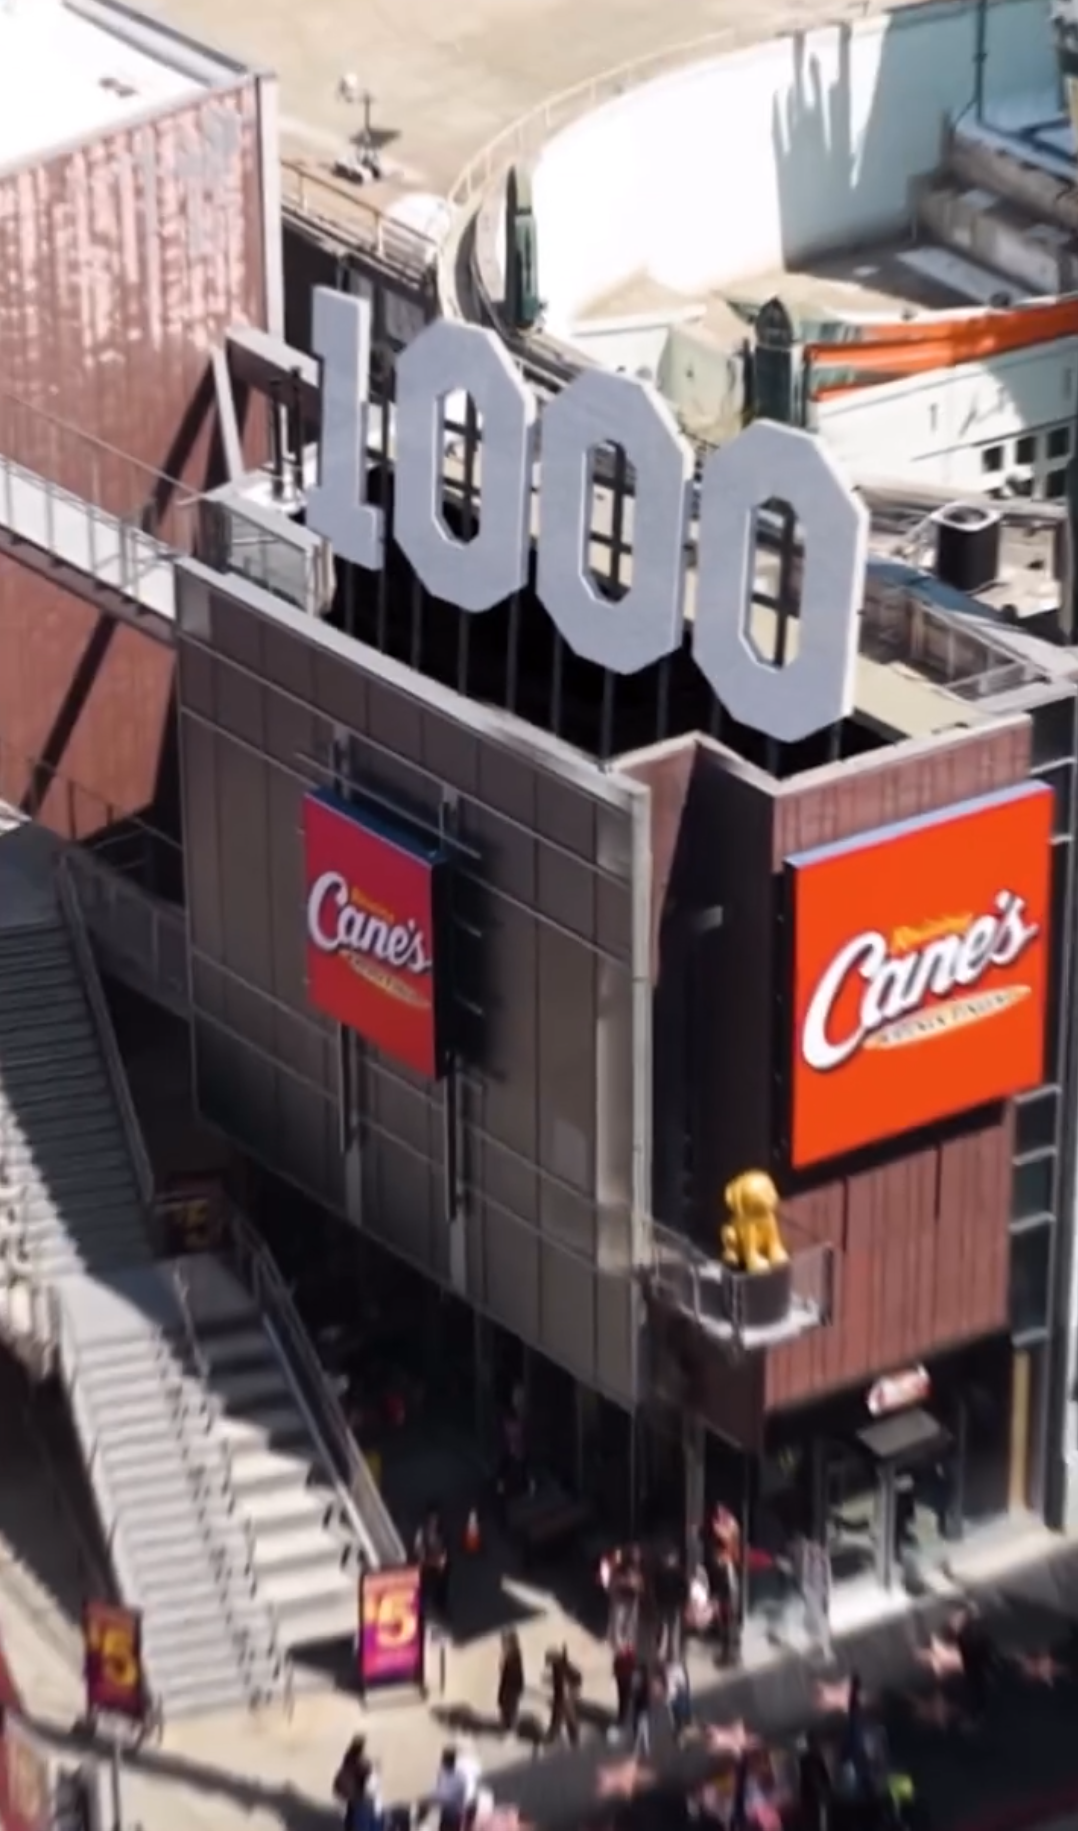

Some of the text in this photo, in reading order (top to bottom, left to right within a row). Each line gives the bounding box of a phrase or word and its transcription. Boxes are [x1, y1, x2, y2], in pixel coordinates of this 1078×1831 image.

[305, 286, 870, 743] 1000
[307, 871, 432, 974] Cane's
[802, 889, 1039, 1070] Cane's
